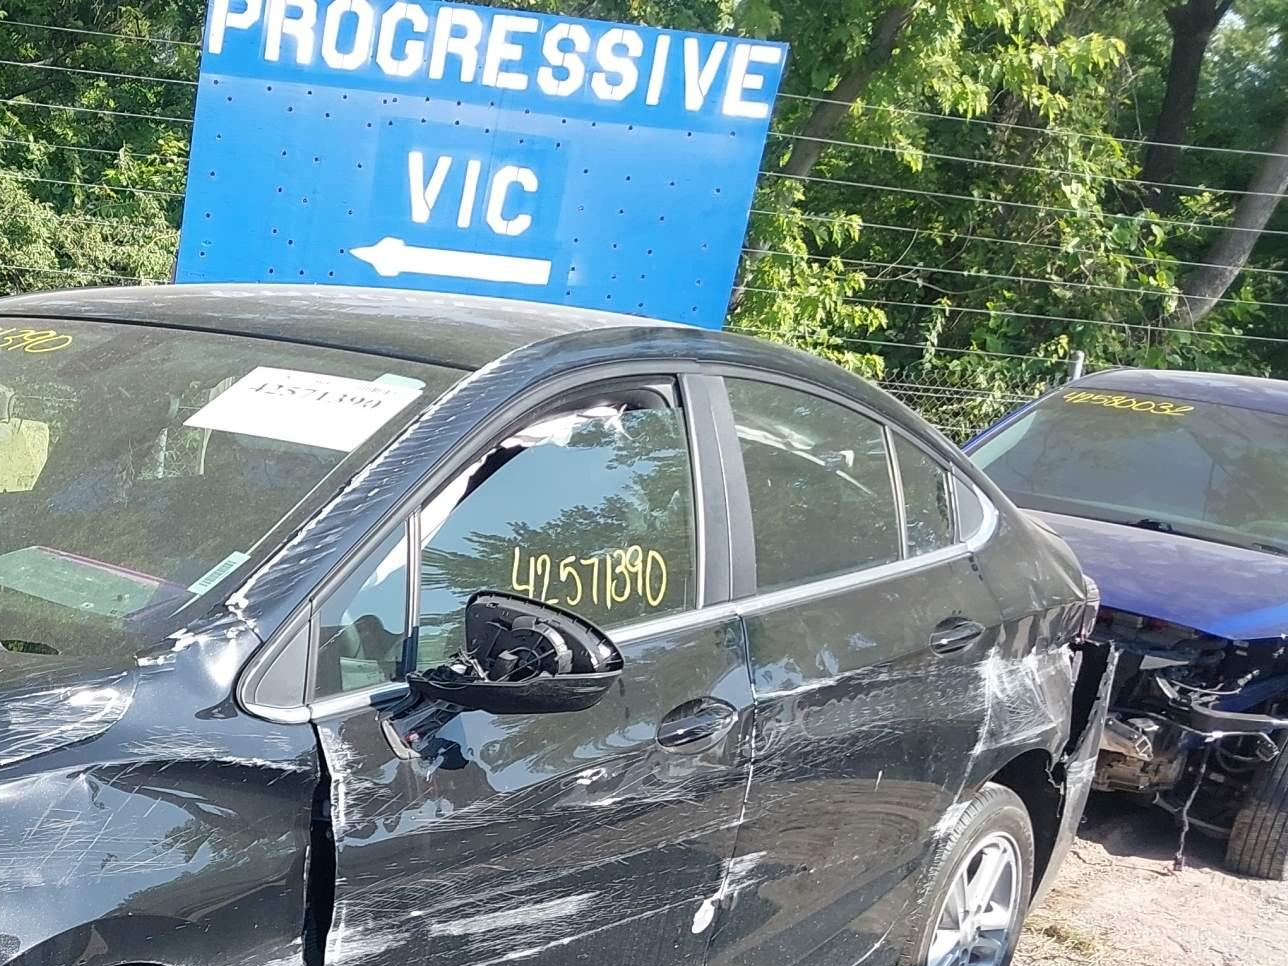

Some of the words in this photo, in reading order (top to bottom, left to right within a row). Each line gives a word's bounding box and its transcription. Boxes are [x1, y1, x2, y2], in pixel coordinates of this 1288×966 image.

[209, 0, 784, 118] PROGRESSIVE
[408, 151, 539, 236] VIC
[512, 545, 667, 610] 42571390
